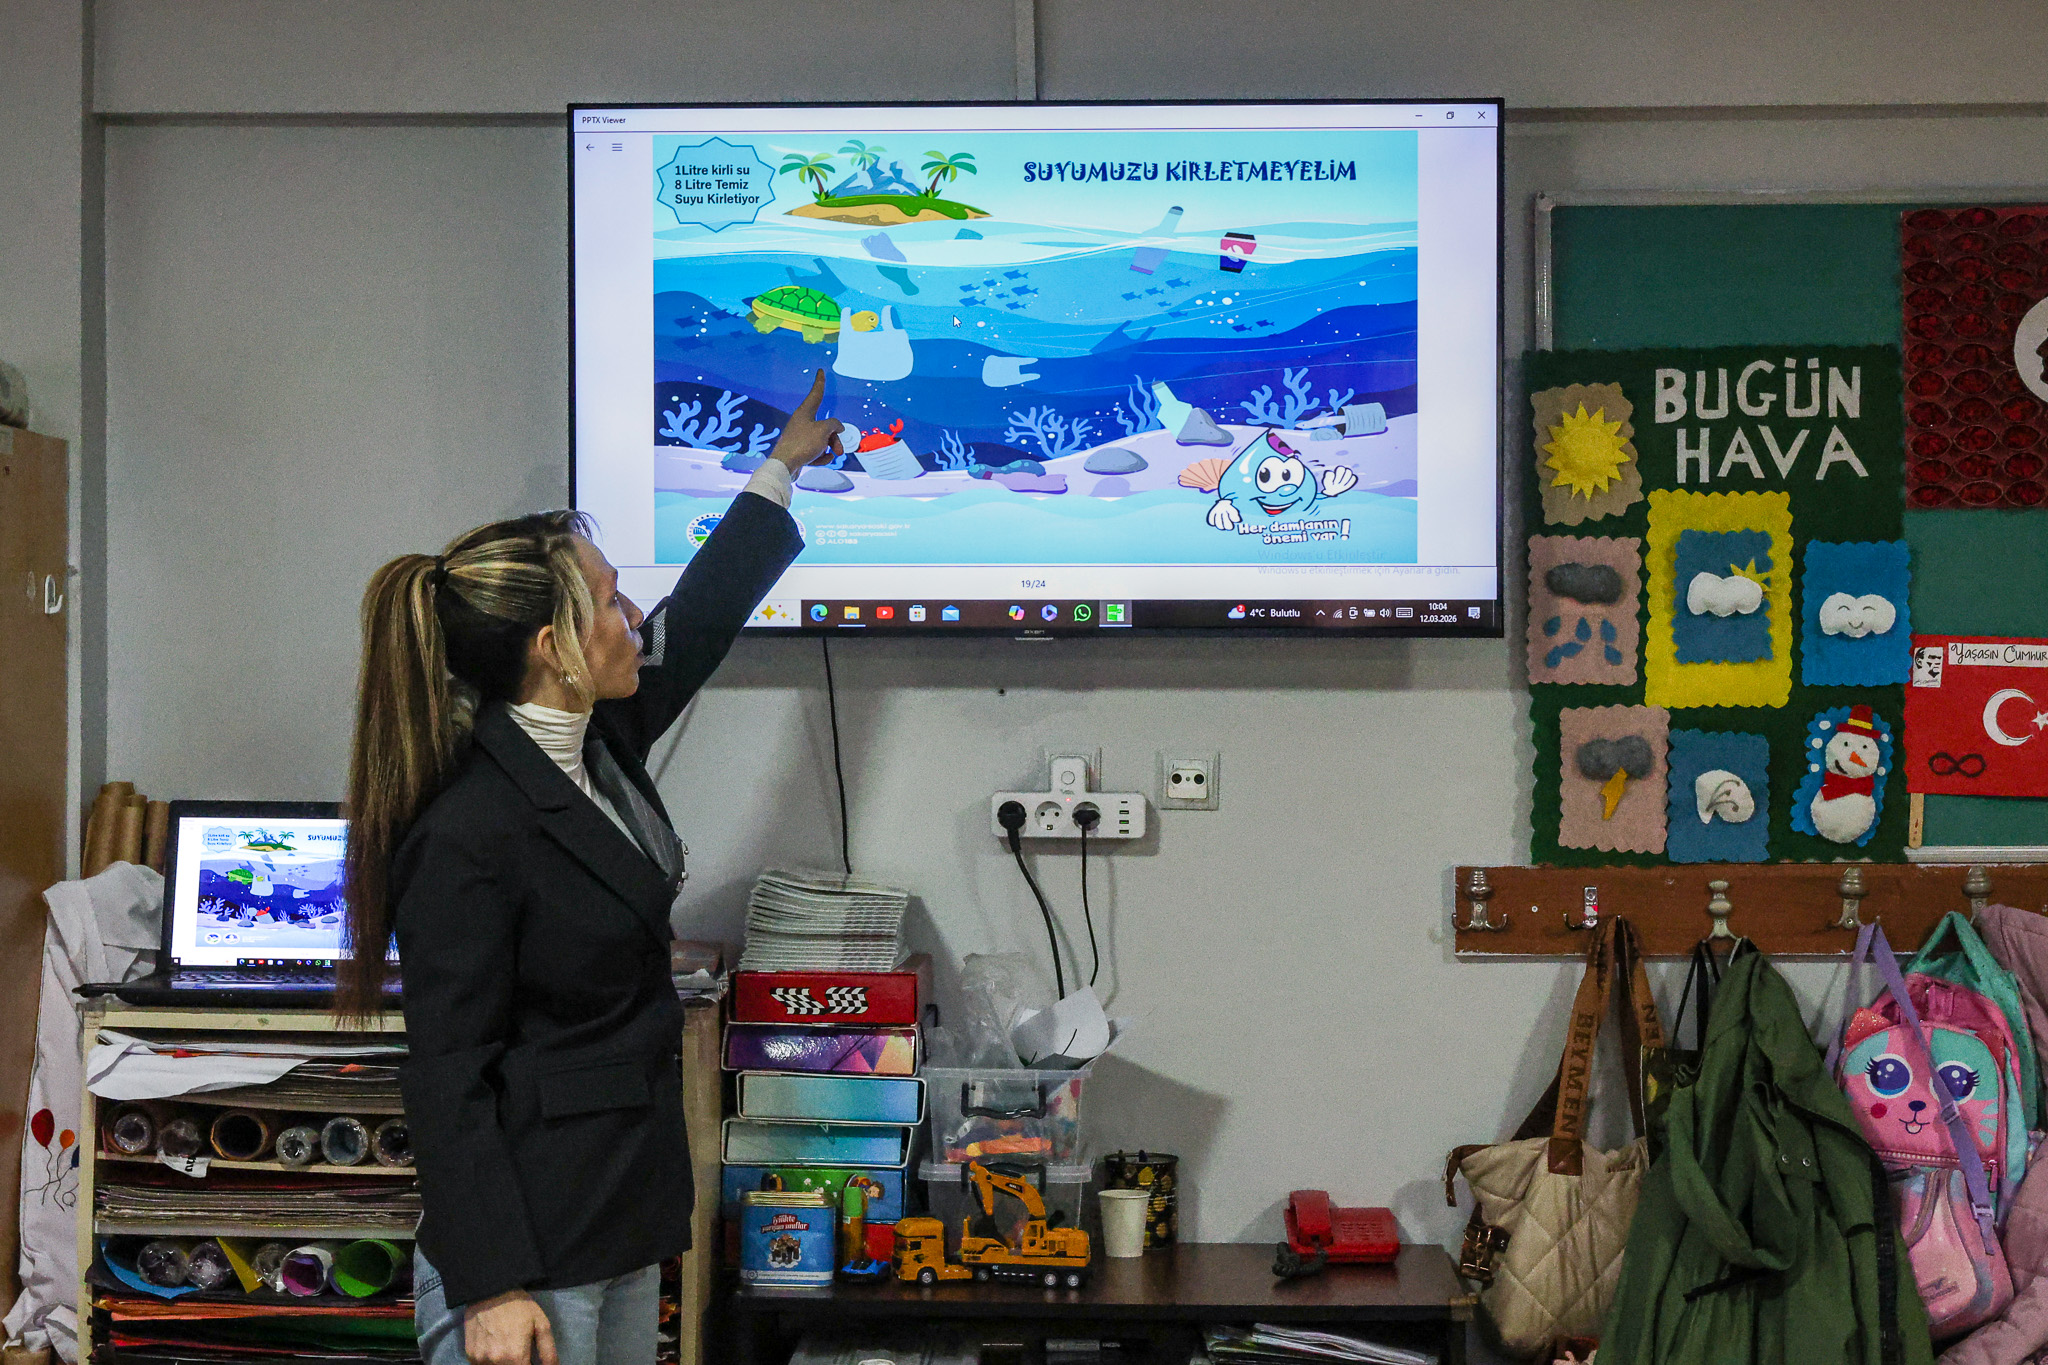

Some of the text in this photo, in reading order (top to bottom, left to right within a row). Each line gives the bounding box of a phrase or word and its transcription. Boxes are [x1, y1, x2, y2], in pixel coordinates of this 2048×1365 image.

[582, 116, 626, 124] PPTX Viewer
[674, 164, 750, 176] 1Litre kirli su
[1023, 160, 1160, 183] SUYUMUZU
[674, 179, 749, 190] 8 Litre Temiz
[674, 193, 760, 206] Suyu Kirletiyor
[1655, 357, 1861, 424] BUGÜN
[1677, 424, 1869, 484] HAVA
[1238, 522, 1267, 535] Her
[1269, 518, 1340, 534] damlanın
[1262, 530, 1309, 545] önemi
[1021, 580, 1046, 588] 19/24
[1428, 602, 1448, 611] 10:04
[1249, 608, 1301, 618] 4°C Bulutlu
[1420, 614, 1458, 623] 12.03.2026
[1560, 1011, 1596, 1138] BEYMEN
